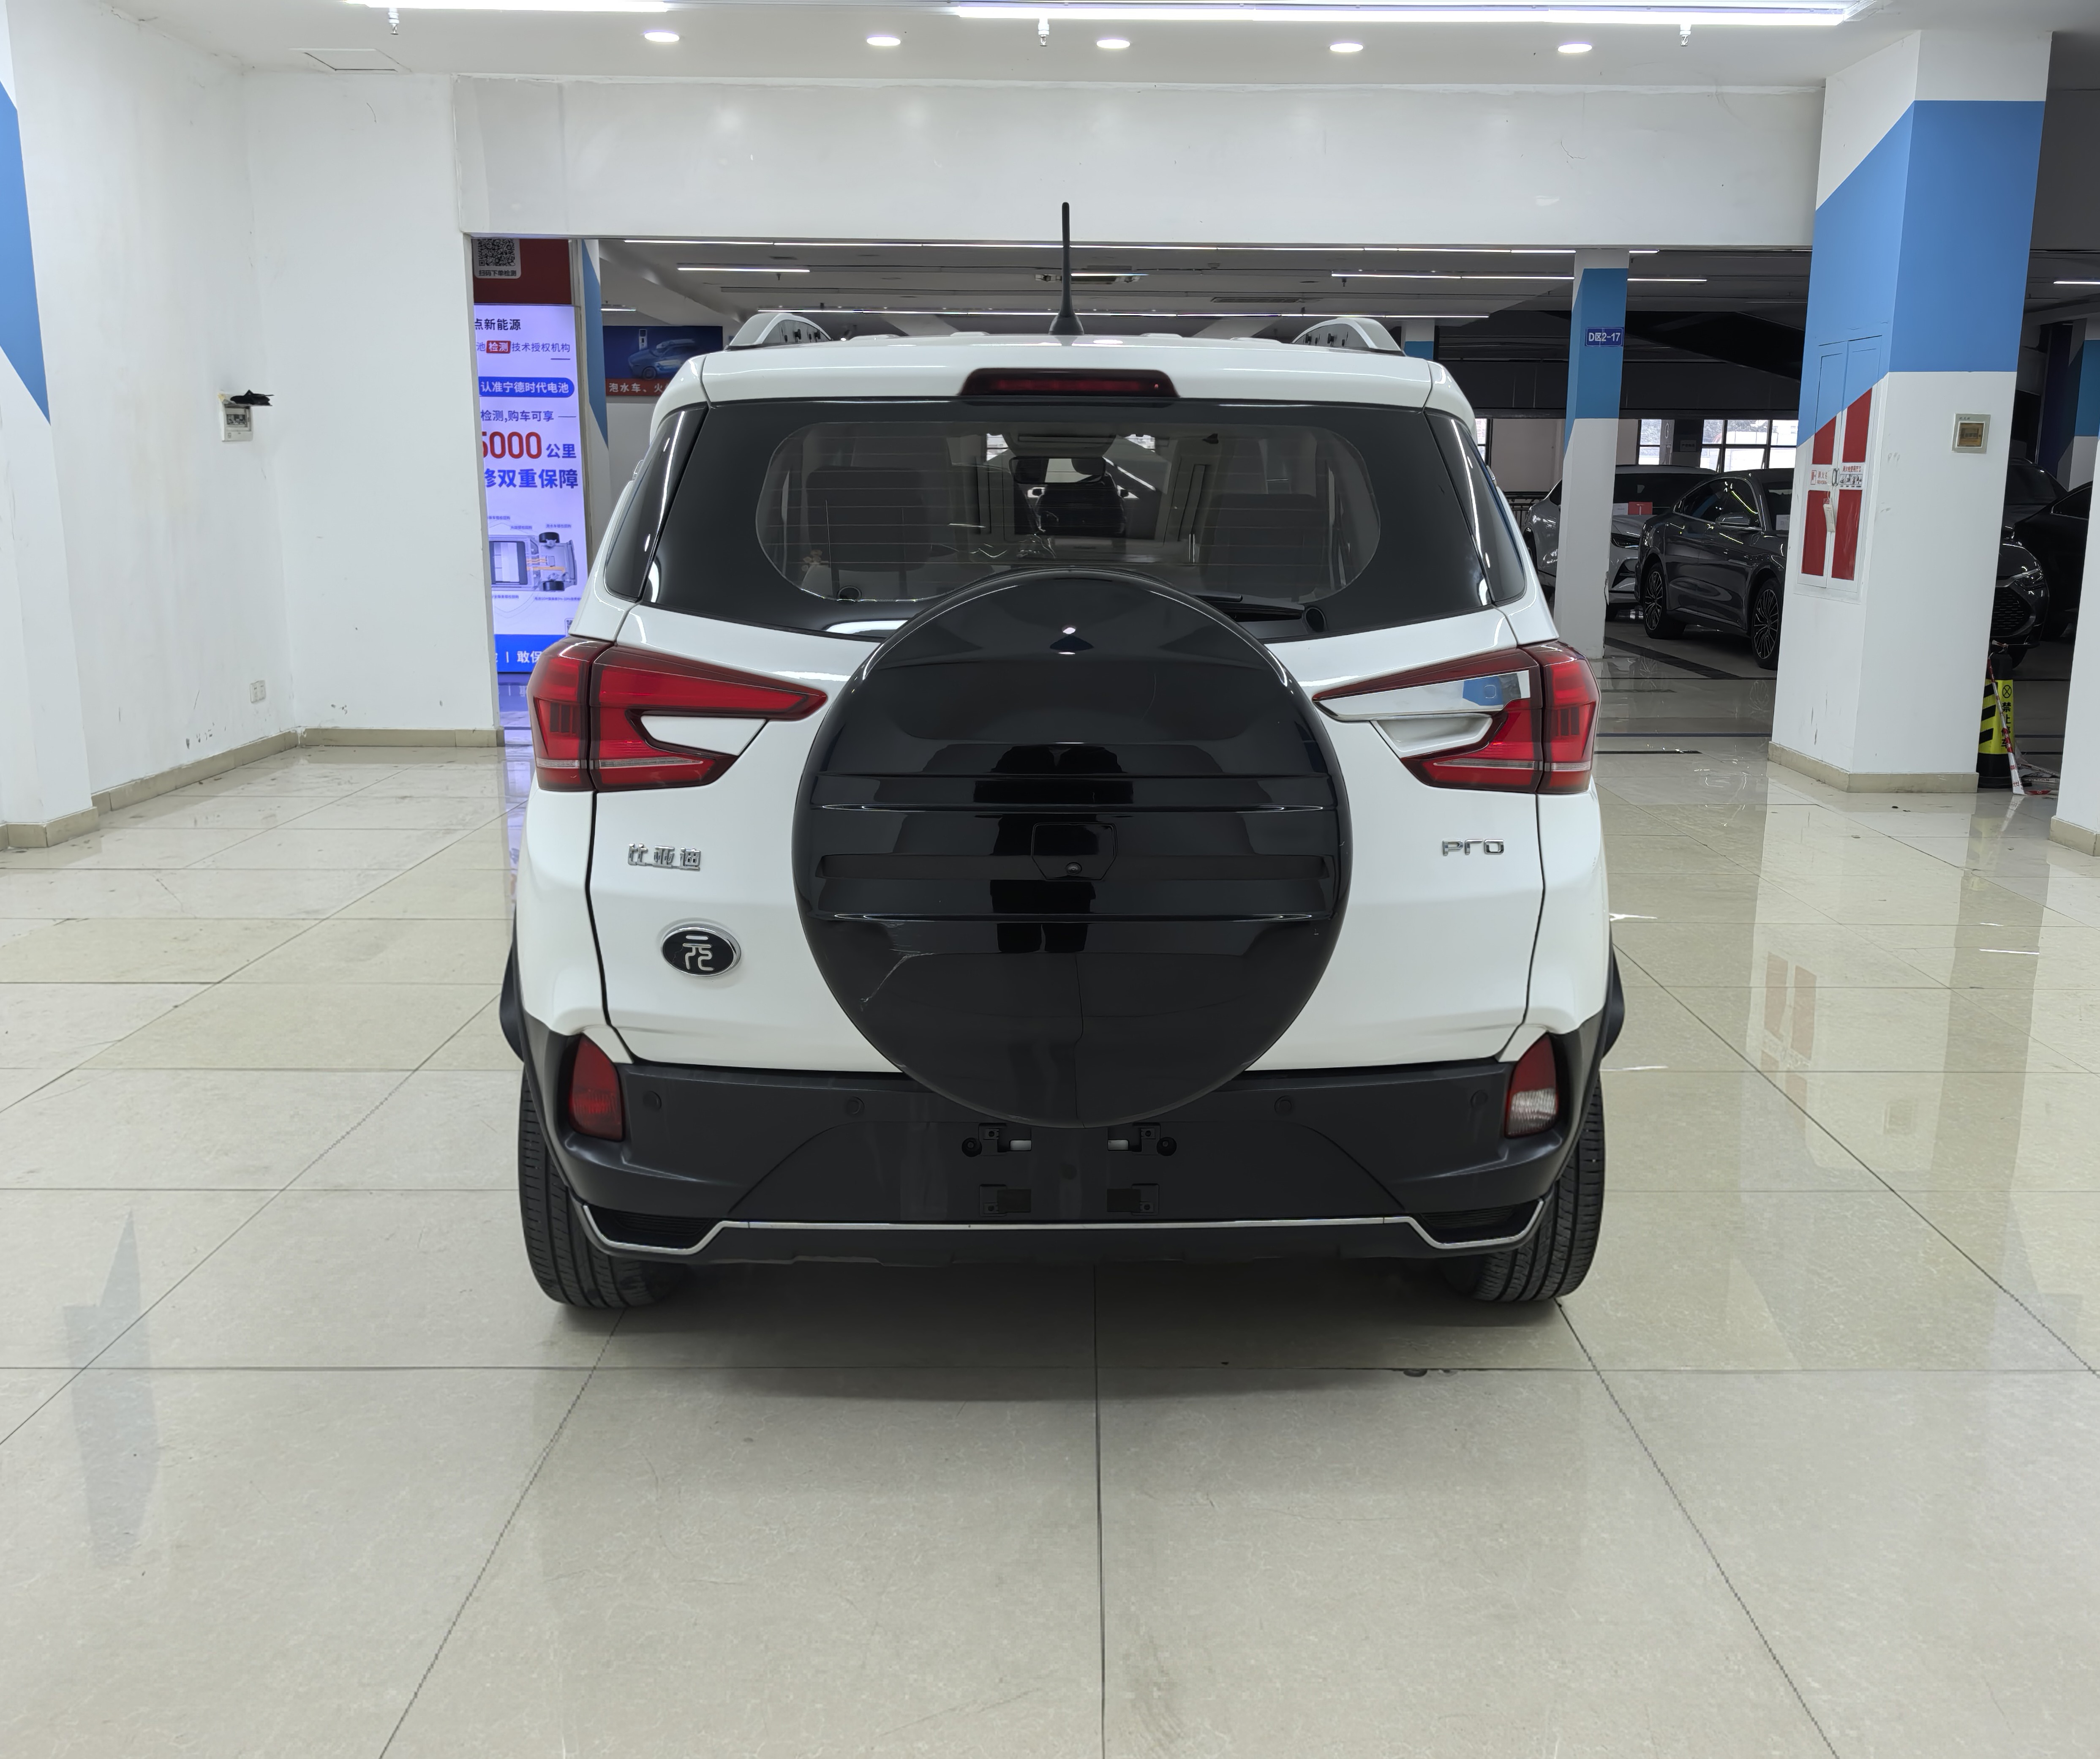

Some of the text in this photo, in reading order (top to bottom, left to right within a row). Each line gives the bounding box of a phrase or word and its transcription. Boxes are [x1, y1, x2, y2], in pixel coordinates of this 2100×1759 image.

[474, 318, 521, 330] 点新能源
[1589, 333, 1621, 341] D区2-17
[481, 381, 569, 393] 认准宁德时代电池
[609, 382, 669, 393] 泡水车、火
[481, 410, 554, 423] 检测,购车可享
[546, 443, 576, 458] 公里
[627, 843, 701, 871] 比亚迪
